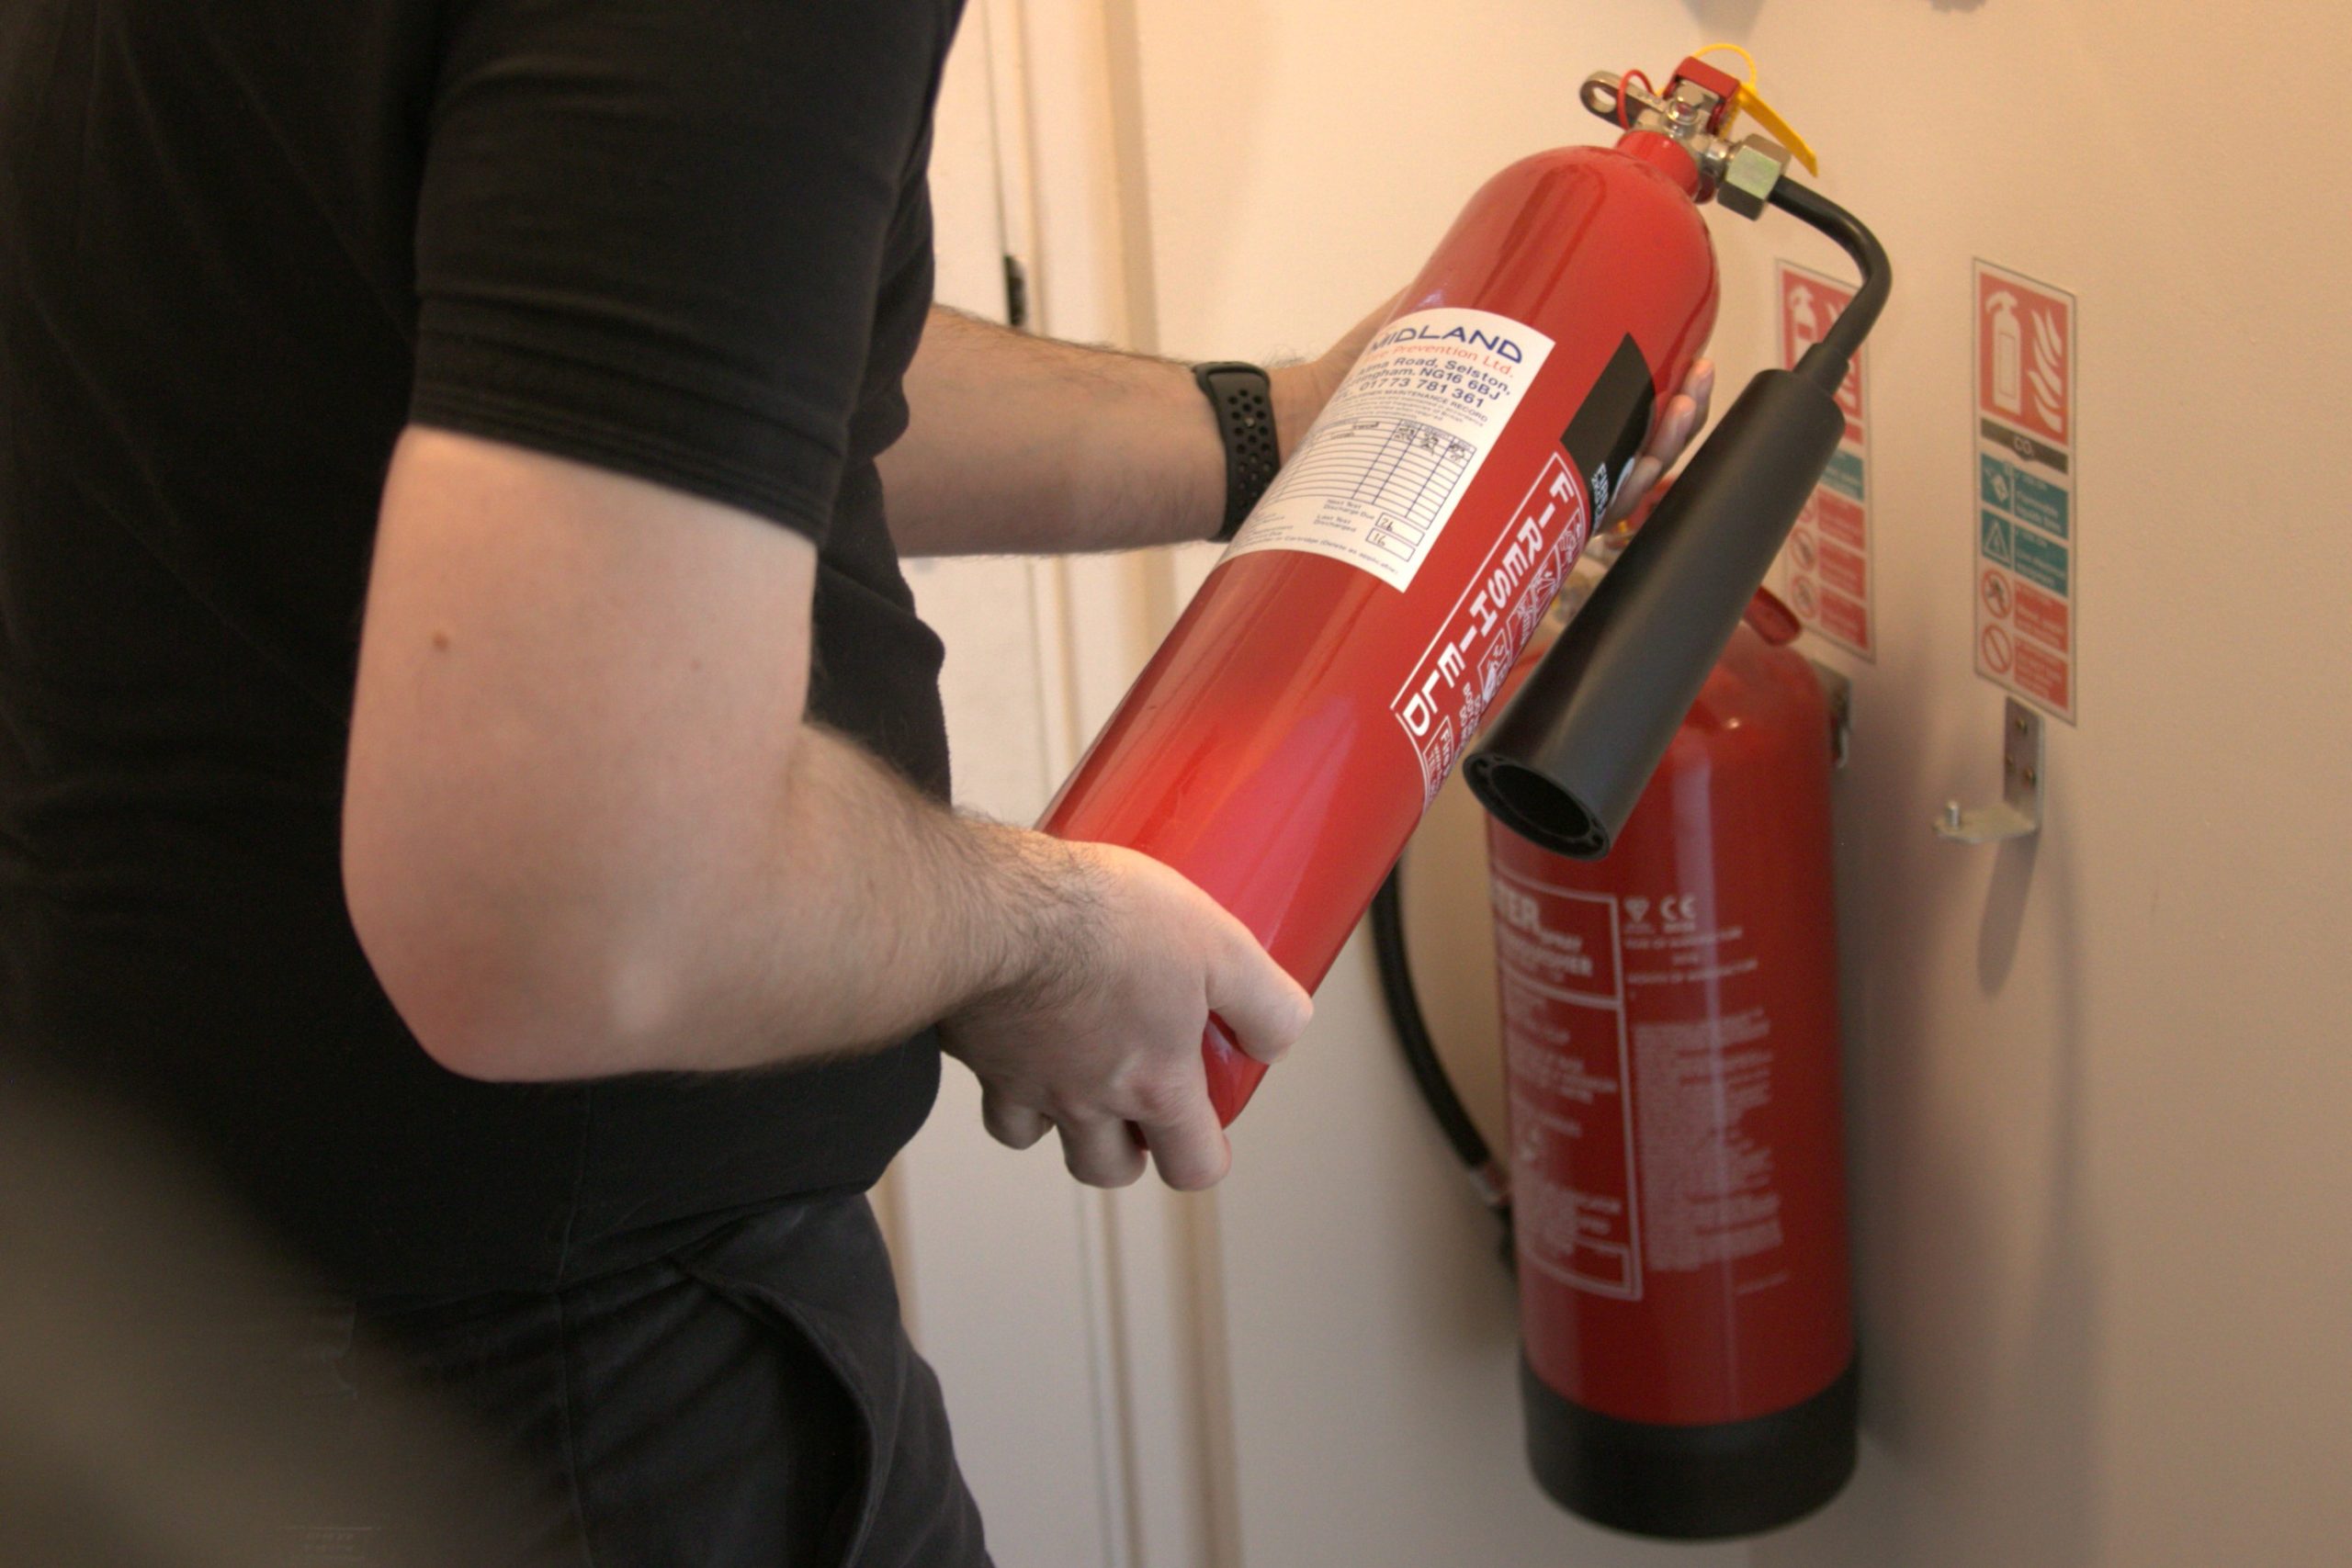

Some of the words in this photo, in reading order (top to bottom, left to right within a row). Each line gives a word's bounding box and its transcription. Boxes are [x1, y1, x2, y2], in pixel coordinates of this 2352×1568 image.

[1372, 325, 1522, 364] MIDLAND
[1393, 344, 1478, 362] Prevention
[1482, 355, 1514, 378] Ltd.
[1360, 378, 1411, 391] 01773
[1416, 379, 1448, 394] 781
[1452, 388, 1486, 409] 361
[1394, 356, 1439, 368] Road,
[1444, 360, 1511, 396] Selston,
[1419, 367, 1463, 384] NG16
[1467, 378, 1501, 400] 6BJ
[1403, 471, 1576, 737] FIRESHIELD
